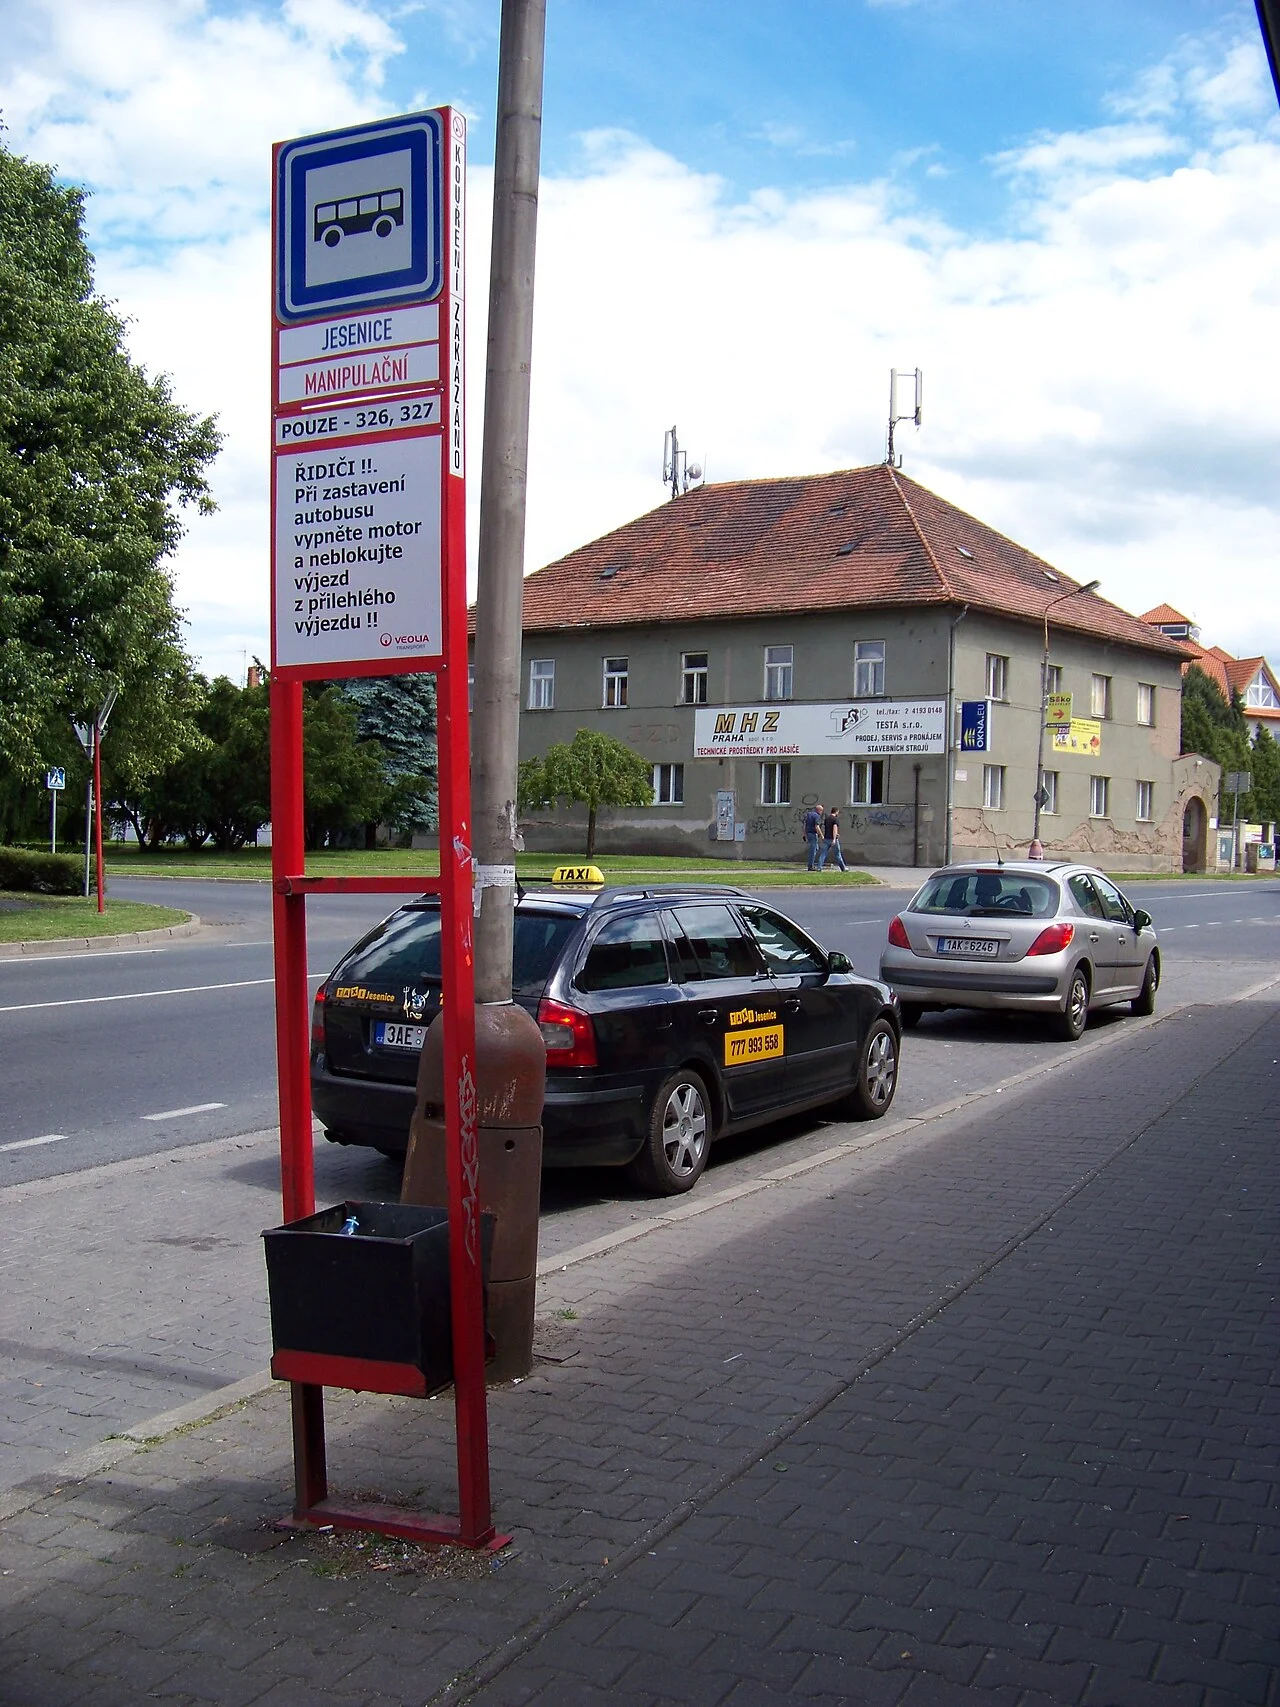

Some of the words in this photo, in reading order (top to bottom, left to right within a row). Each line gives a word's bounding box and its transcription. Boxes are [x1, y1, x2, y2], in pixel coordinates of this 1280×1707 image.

[321, 317, 393, 351] JESENICE
[304, 352, 409, 396] MANIPULAČNÍ
[281, 416, 338, 439] POUZE
[355, 408, 394, 427] 326,
[400, 402, 434, 422] 327
[295, 456, 355, 482] ŘIDIČI
[295, 485, 317, 503] Při
[322, 474, 405, 501] zastavení
[294, 504, 374, 525] autobusu
[294, 525, 363, 550] vypněte
[368, 520, 422, 539] motor
[294, 556, 304, 569] a
[309, 544, 403, 566] neblokujte
[294, 570, 349, 593] výjezd
[294, 598, 303, 612] z
[308, 588, 396, 614] přilehlého
[294, 613, 361, 637] výjezdu
[367, 611, 378, 628] !!
[394, 634, 430, 644] VEOLIA
[875, 720, 899, 729] TESTA
[976, 704, 985, 748] OKNA.EU
[711, 734, 745, 743] PRAHA
[855, 734, 880, 742] PRODEJ,
[881, 733, 903, 742] SERVIS
[766, 745, 778, 754] PRO
[559, 868, 590, 880] TAXI
[947, 940, 963, 951] 1AK
[969, 941, 994, 952] 6246
[336, 986, 366, 1000] TAXI
[366, 990, 396, 1003] Jesenice
[386, 1025, 414, 1046] 3AE
[730, 1039, 746, 1057] 777
[748, 1036, 763, 1054] 993
[764, 1034, 779, 1051] 558
